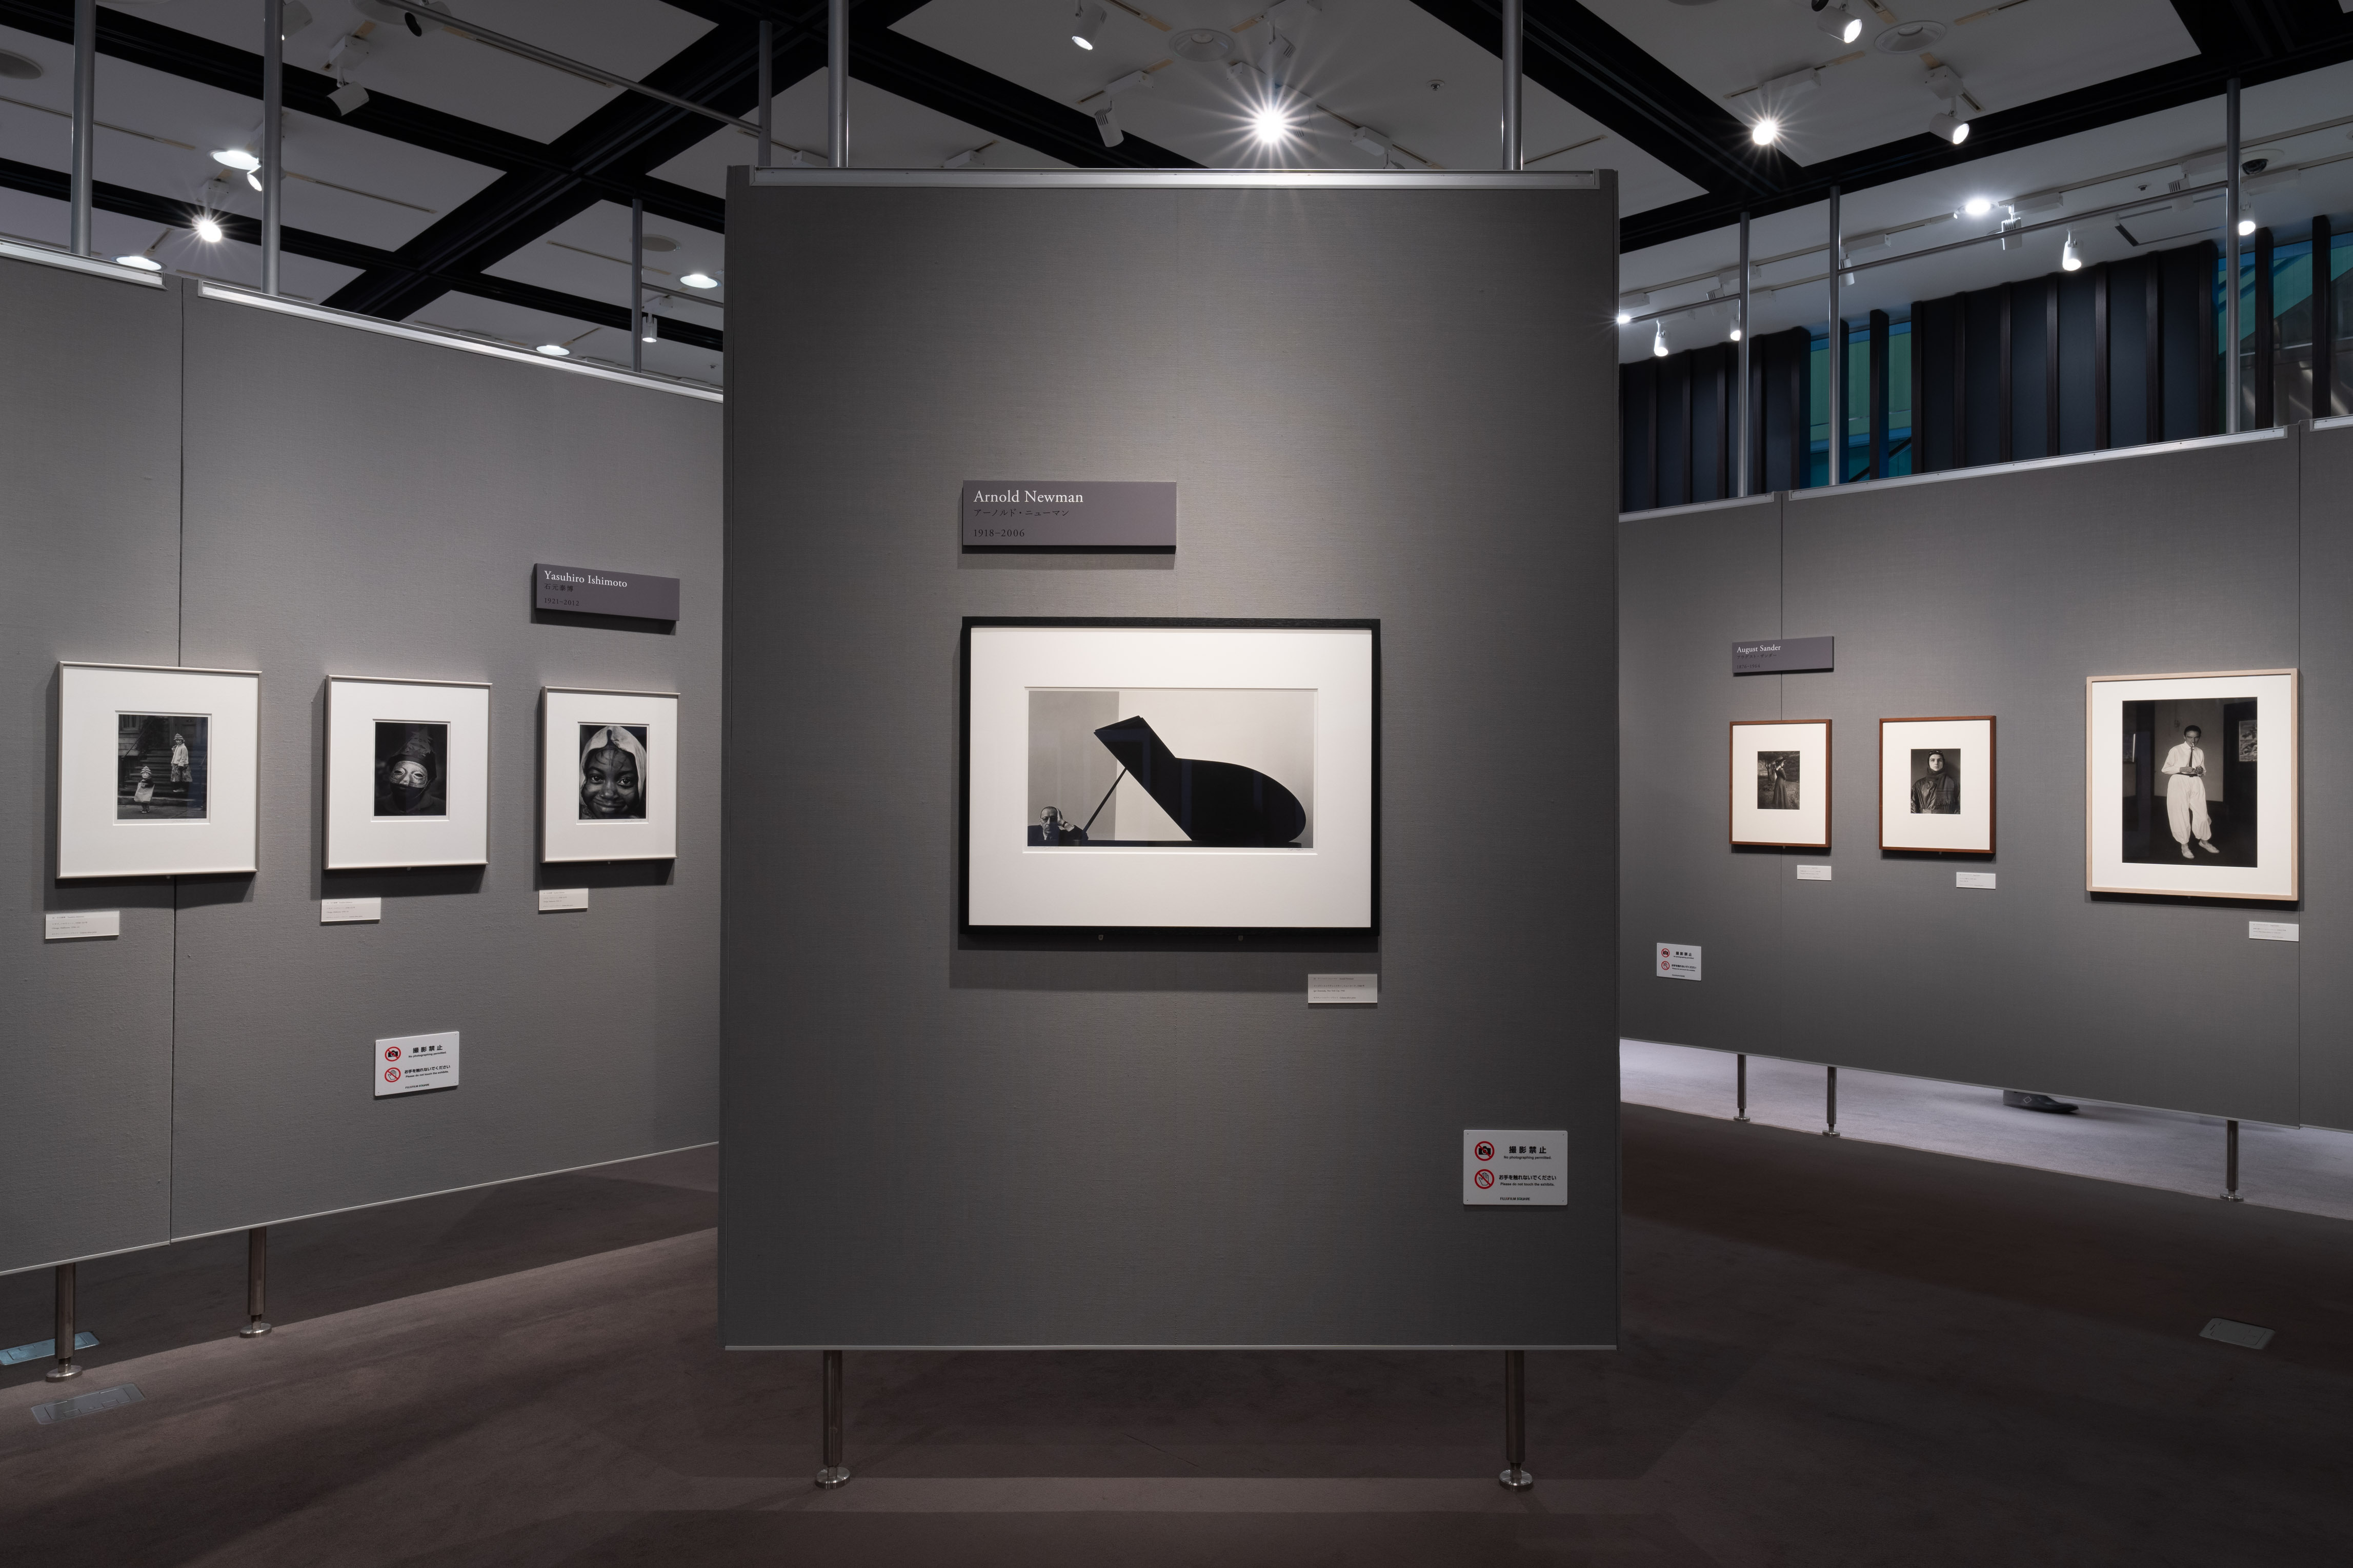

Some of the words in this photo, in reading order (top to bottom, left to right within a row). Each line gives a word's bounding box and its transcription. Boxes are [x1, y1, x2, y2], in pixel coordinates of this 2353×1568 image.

[974, 490, 1019, 502] Arnold
[1024, 490, 1083, 502] Newman
[974, 508, 1069, 517] アーノルド・ニューマン
[974, 529, 1024, 537] 1918–2006
[544, 571, 585, 583] Yasuhiro
[588, 575, 627, 587] Ishimoto
[544, 583, 573, 592] 石元泰博
[545, 598, 579, 606] 1921–2012
[413, 1045, 443, 1053] 撮影禁止
[405, 1065, 451, 1074] お手を触れないでください
